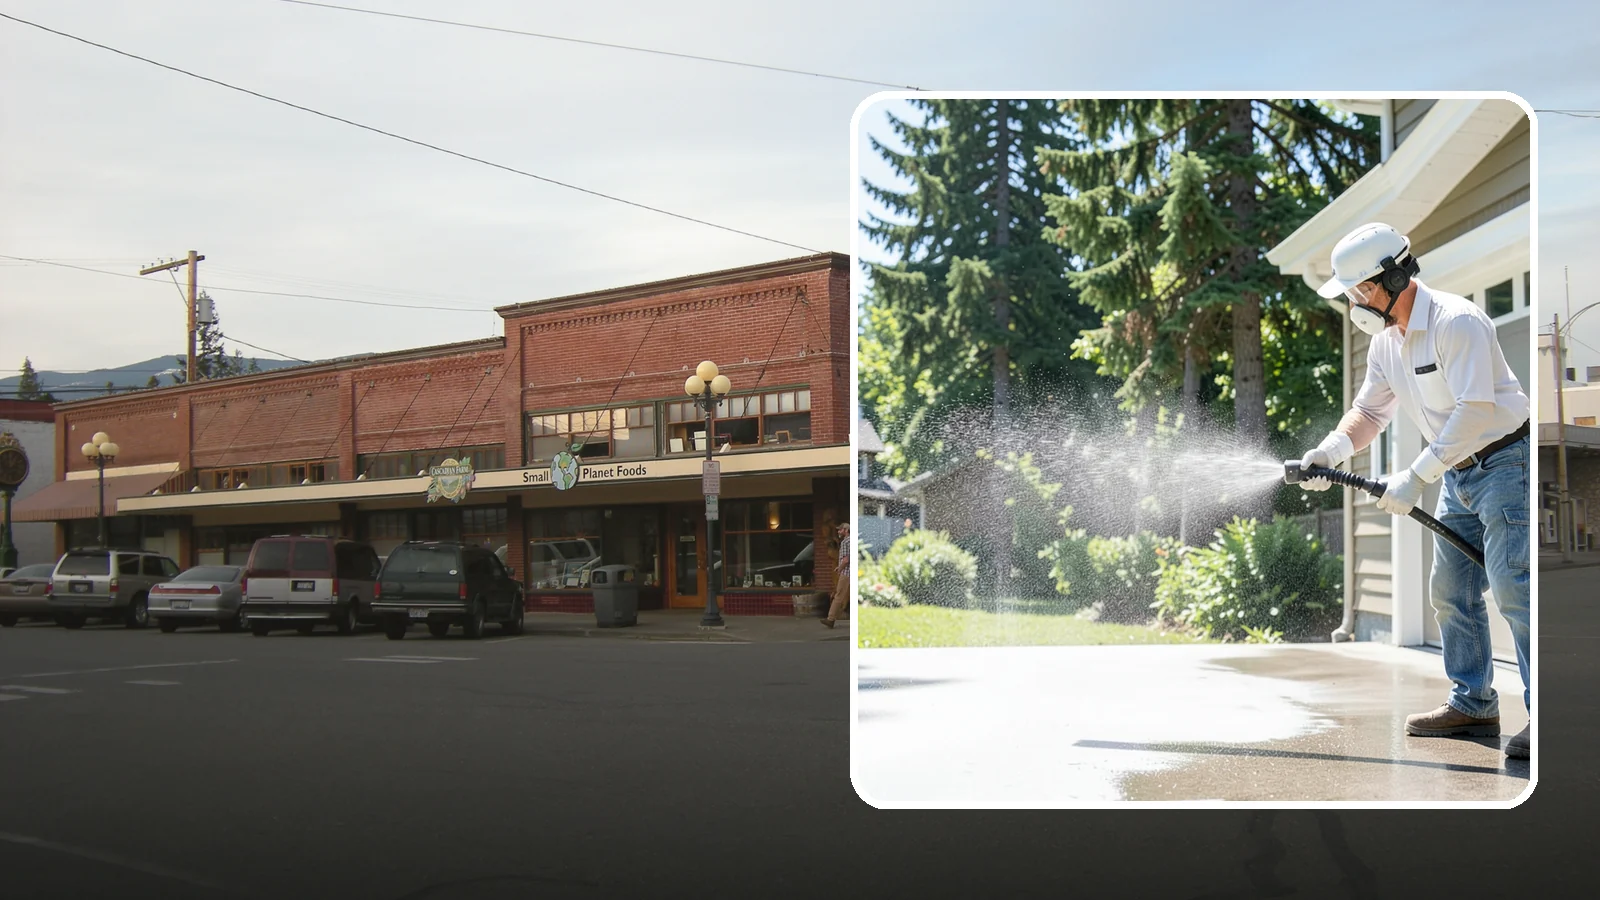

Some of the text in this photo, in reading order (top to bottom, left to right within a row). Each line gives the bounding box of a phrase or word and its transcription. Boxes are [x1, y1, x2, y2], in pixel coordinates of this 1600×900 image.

[432, 467, 456, 476] CASCADIAN
[523, 464, 647, 483] Small Planet Foods
